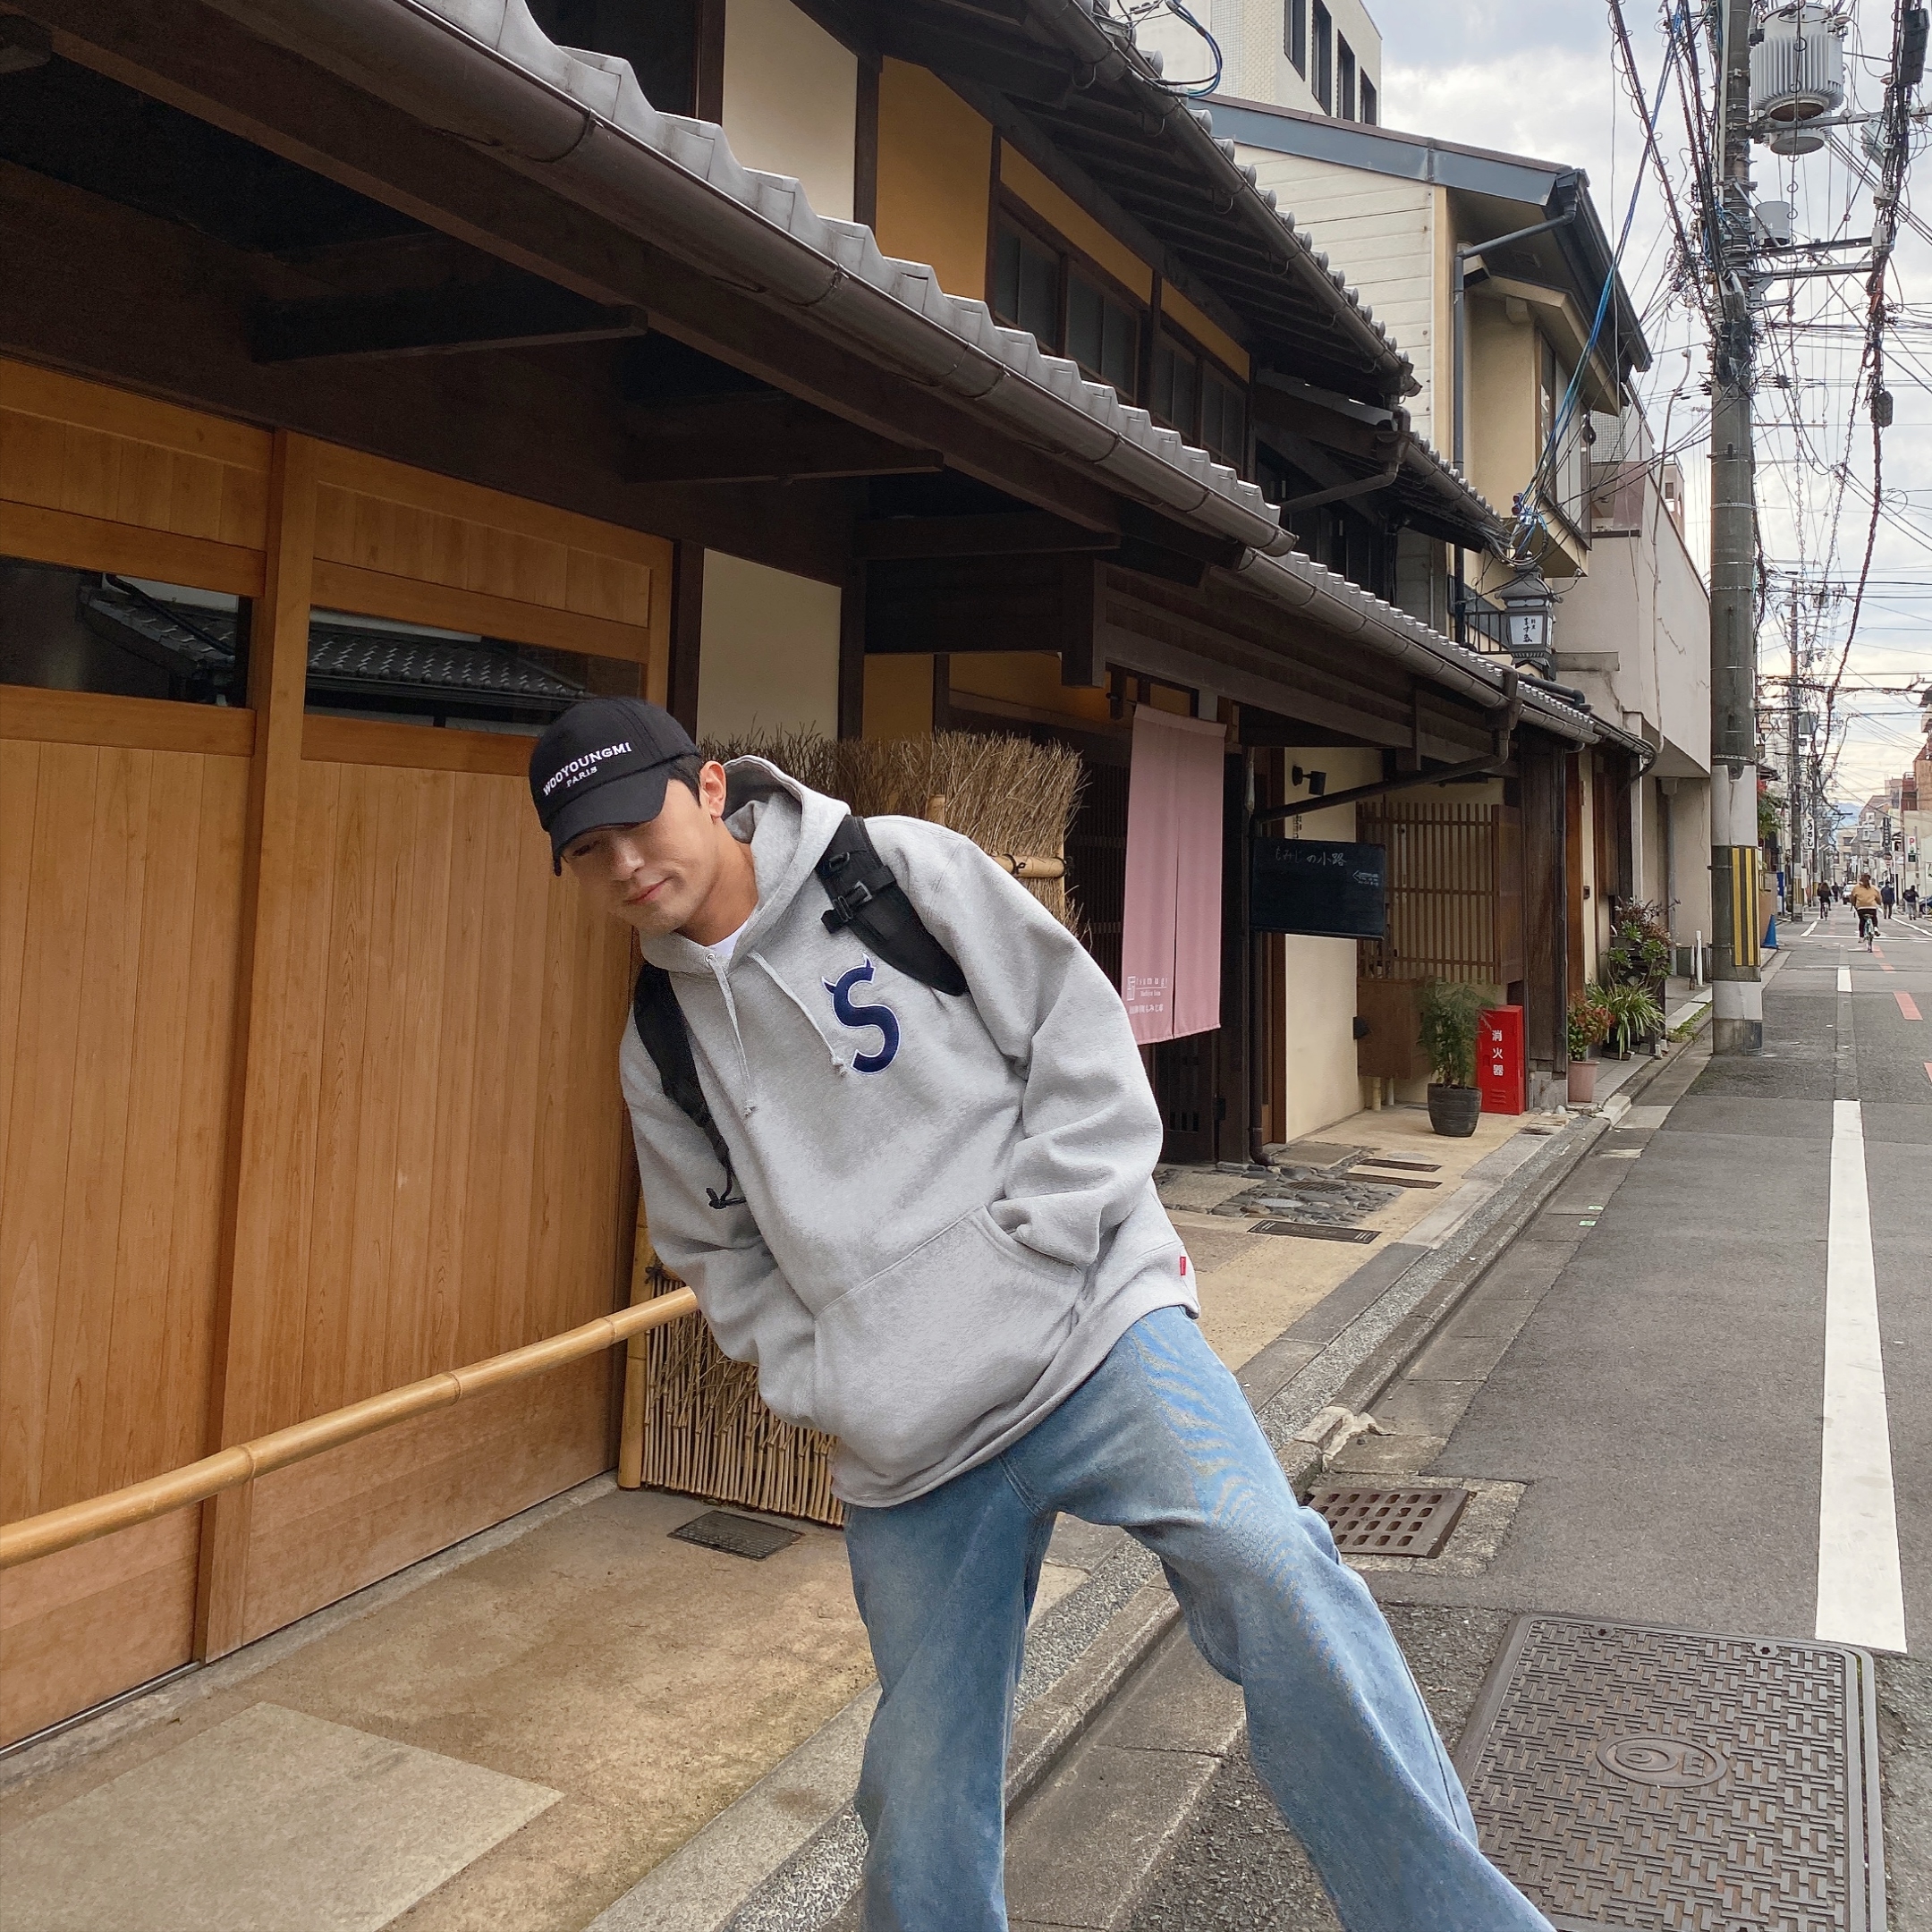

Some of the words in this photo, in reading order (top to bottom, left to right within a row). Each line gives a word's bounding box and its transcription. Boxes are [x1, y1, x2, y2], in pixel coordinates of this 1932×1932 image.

[542, 741, 632, 797] WOOYOUNGMI
[567, 767, 597, 787] PARIS
[1275, 846, 1347, 867] もみじの小路
[1909, 837, 1915, 845] P
[821, 953, 902, 1075] S
[1492, 1030, 1504, 1076] 消火器
